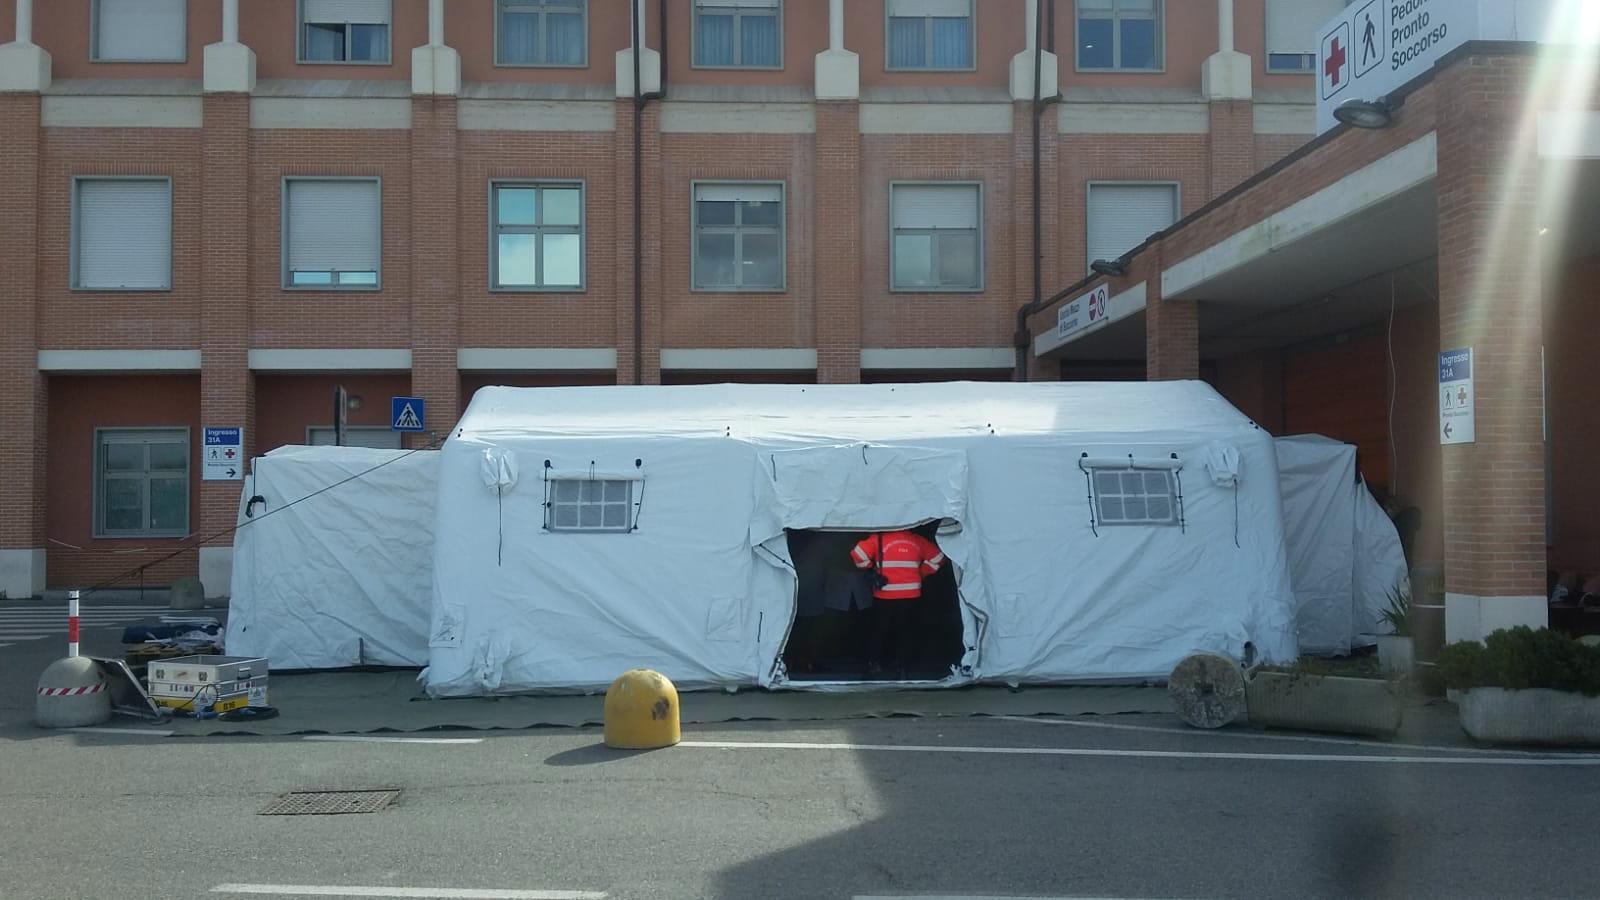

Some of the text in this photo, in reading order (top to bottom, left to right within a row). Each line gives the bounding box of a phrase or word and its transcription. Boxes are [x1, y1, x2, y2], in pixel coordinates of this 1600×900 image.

[1391, 11, 1430, 49] Pronto
[1391, 22, 1447, 71] Soccorso
[1441, 352, 1469, 367] Ingresso
[1441, 367, 1454, 379] 31A
